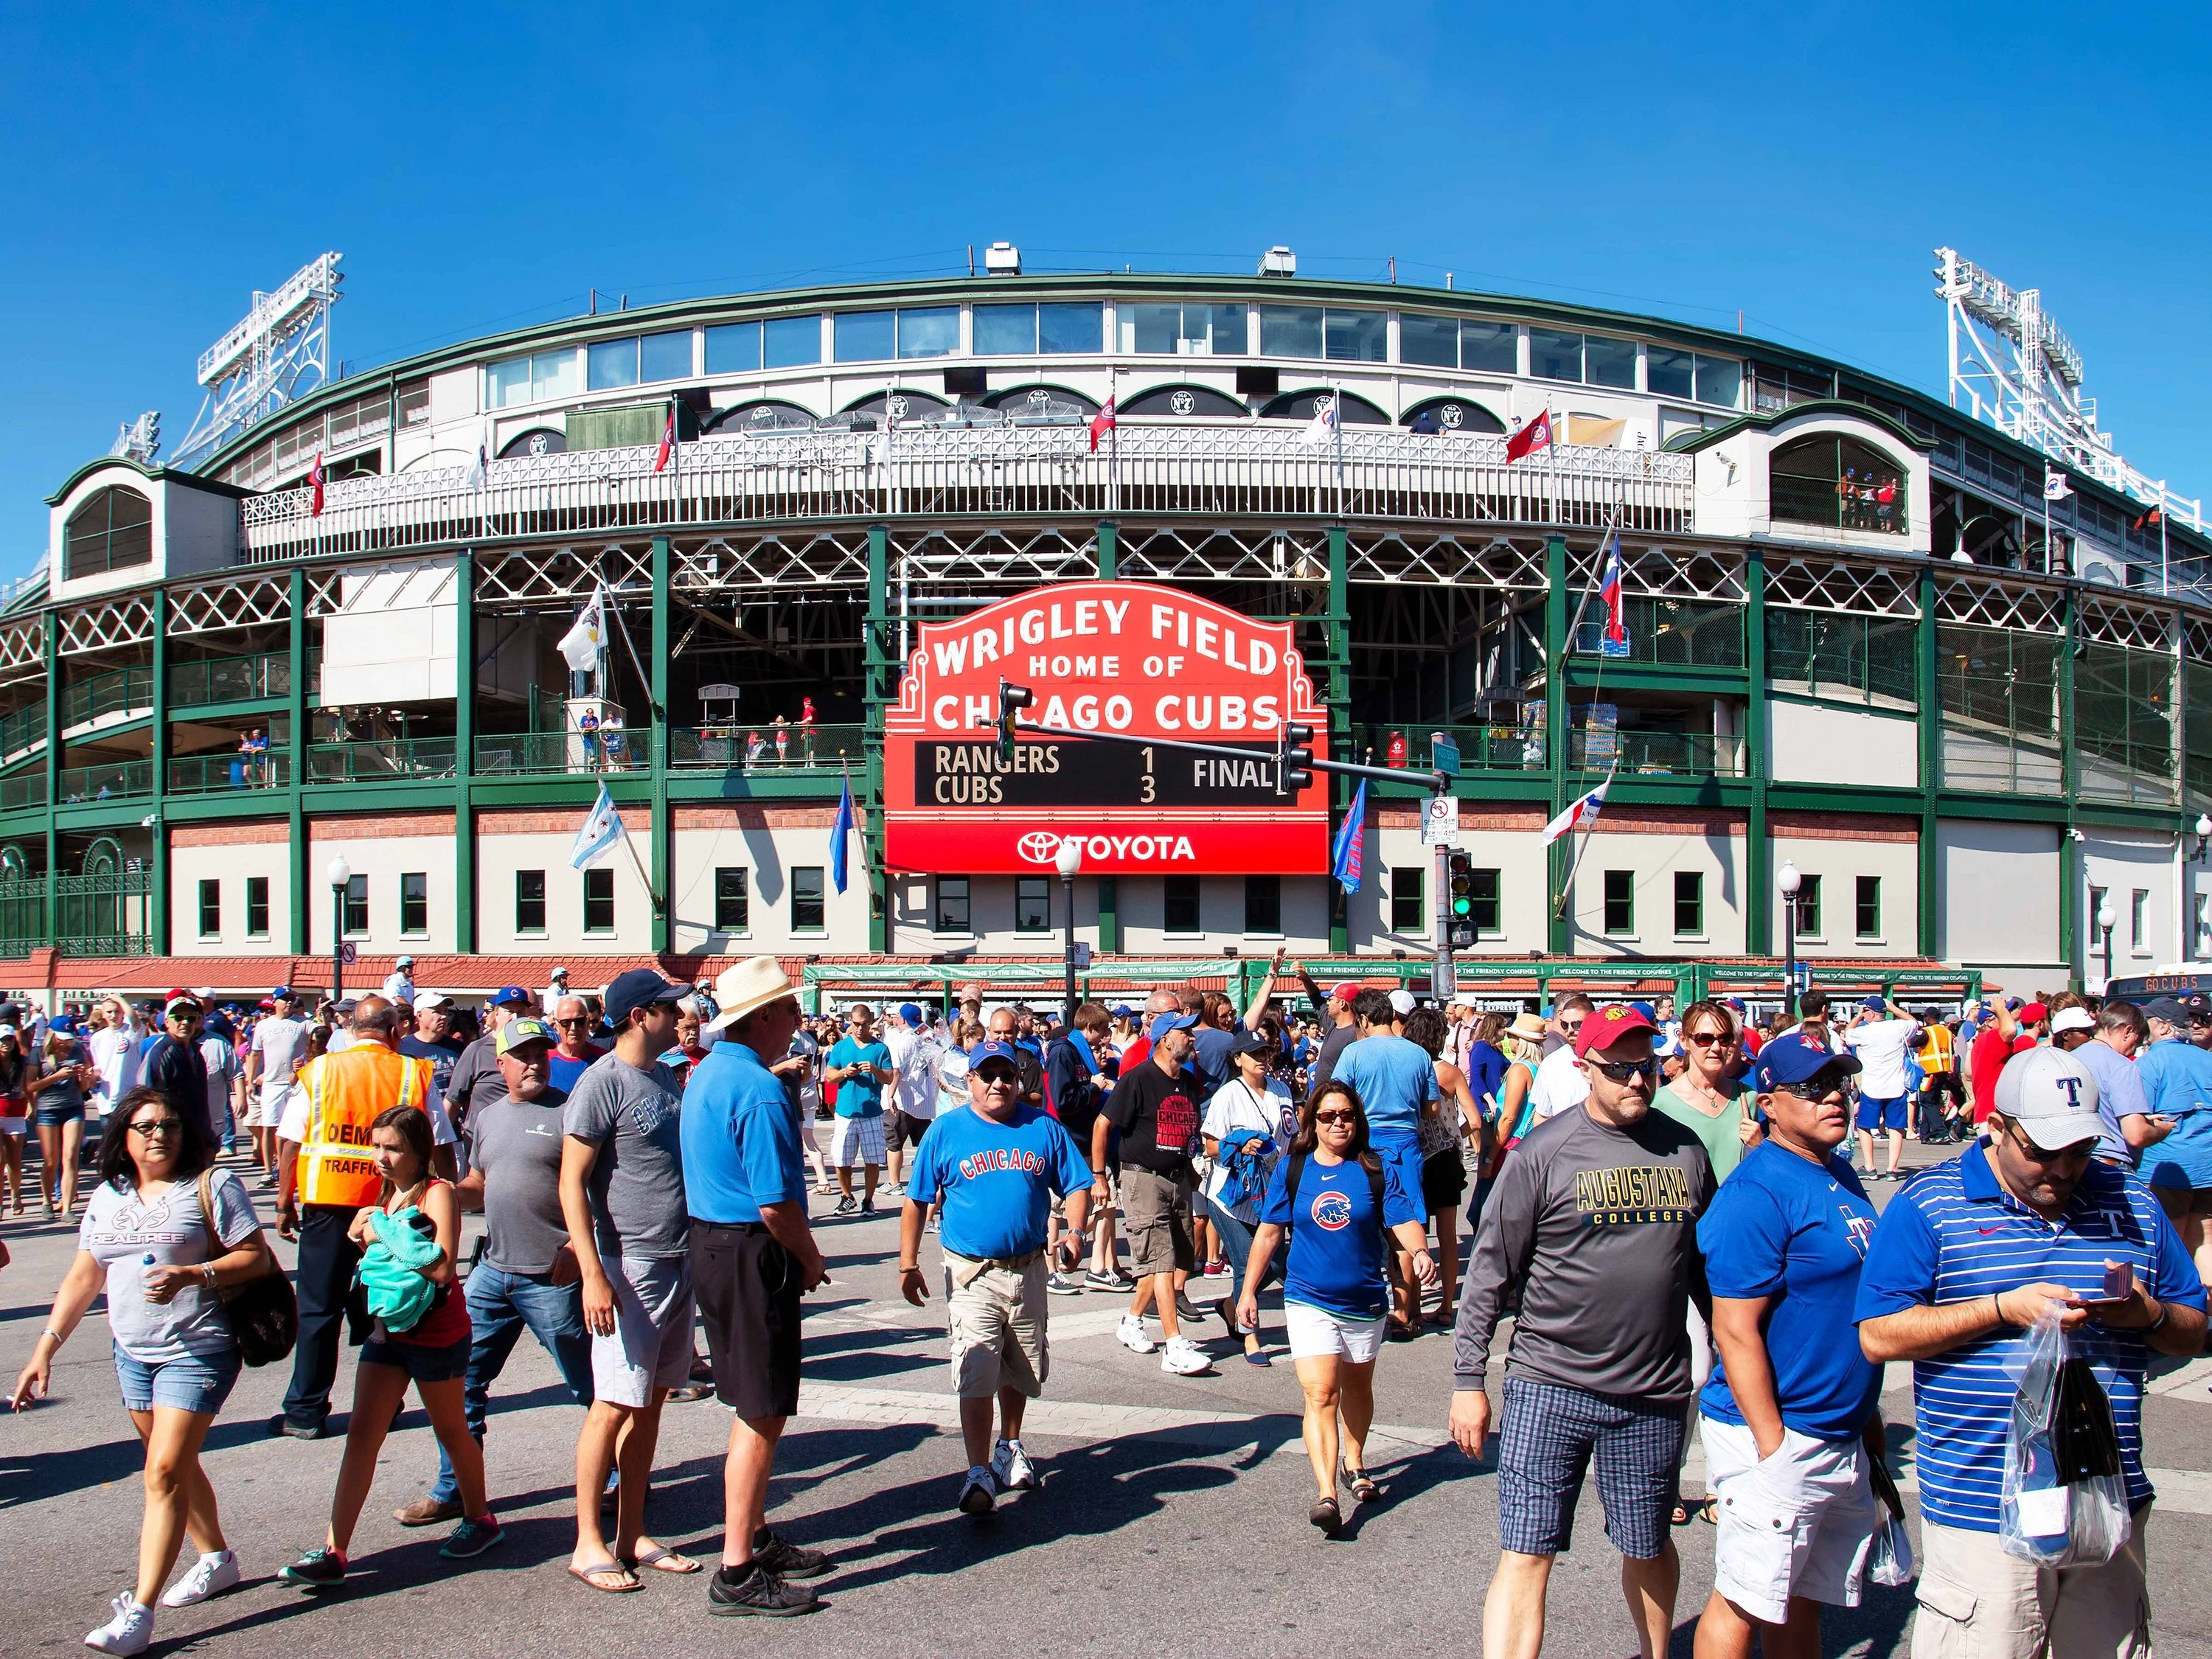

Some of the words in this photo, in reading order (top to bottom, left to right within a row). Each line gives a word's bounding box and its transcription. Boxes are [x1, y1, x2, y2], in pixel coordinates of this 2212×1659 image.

[933, 600, 1130, 677] WRIGLEY
[1152, 603, 1277, 675] FIELD
[1029, 655, 1119, 678] HOME
[1143, 655, 1185, 678] OF
[933, 695, 1133, 730] CHCAGO
[1155, 695, 1279, 731] CUBS
[1141, 746, 1153, 773] 1
[1194, 759, 1273, 787] FINAL
[935, 776, 1003, 804] CUBS
[1141, 775, 1155, 804] 3
[2146, 978, 2157, 991] GO
[2162, 976, 2198, 990] CUBS
[2190, 996, 2201, 1006] C
[268, 1026, 302, 1037] TEXAS
[984, 1041, 1001, 1051] C
[1760, 1066, 1771, 1086] T
[2056, 1077, 2083, 1107] T
[1157, 1123, 1191, 1136] WANTS
[960, 1148, 1046, 1180] CHICAGO
[1576, 1166, 1691, 1211] AUGUSTANA
[1593, 1211, 1683, 1225] COLLEGE
[2099, 1207, 2125, 1238] T
[91, 1231, 186, 1245] REALTREE
